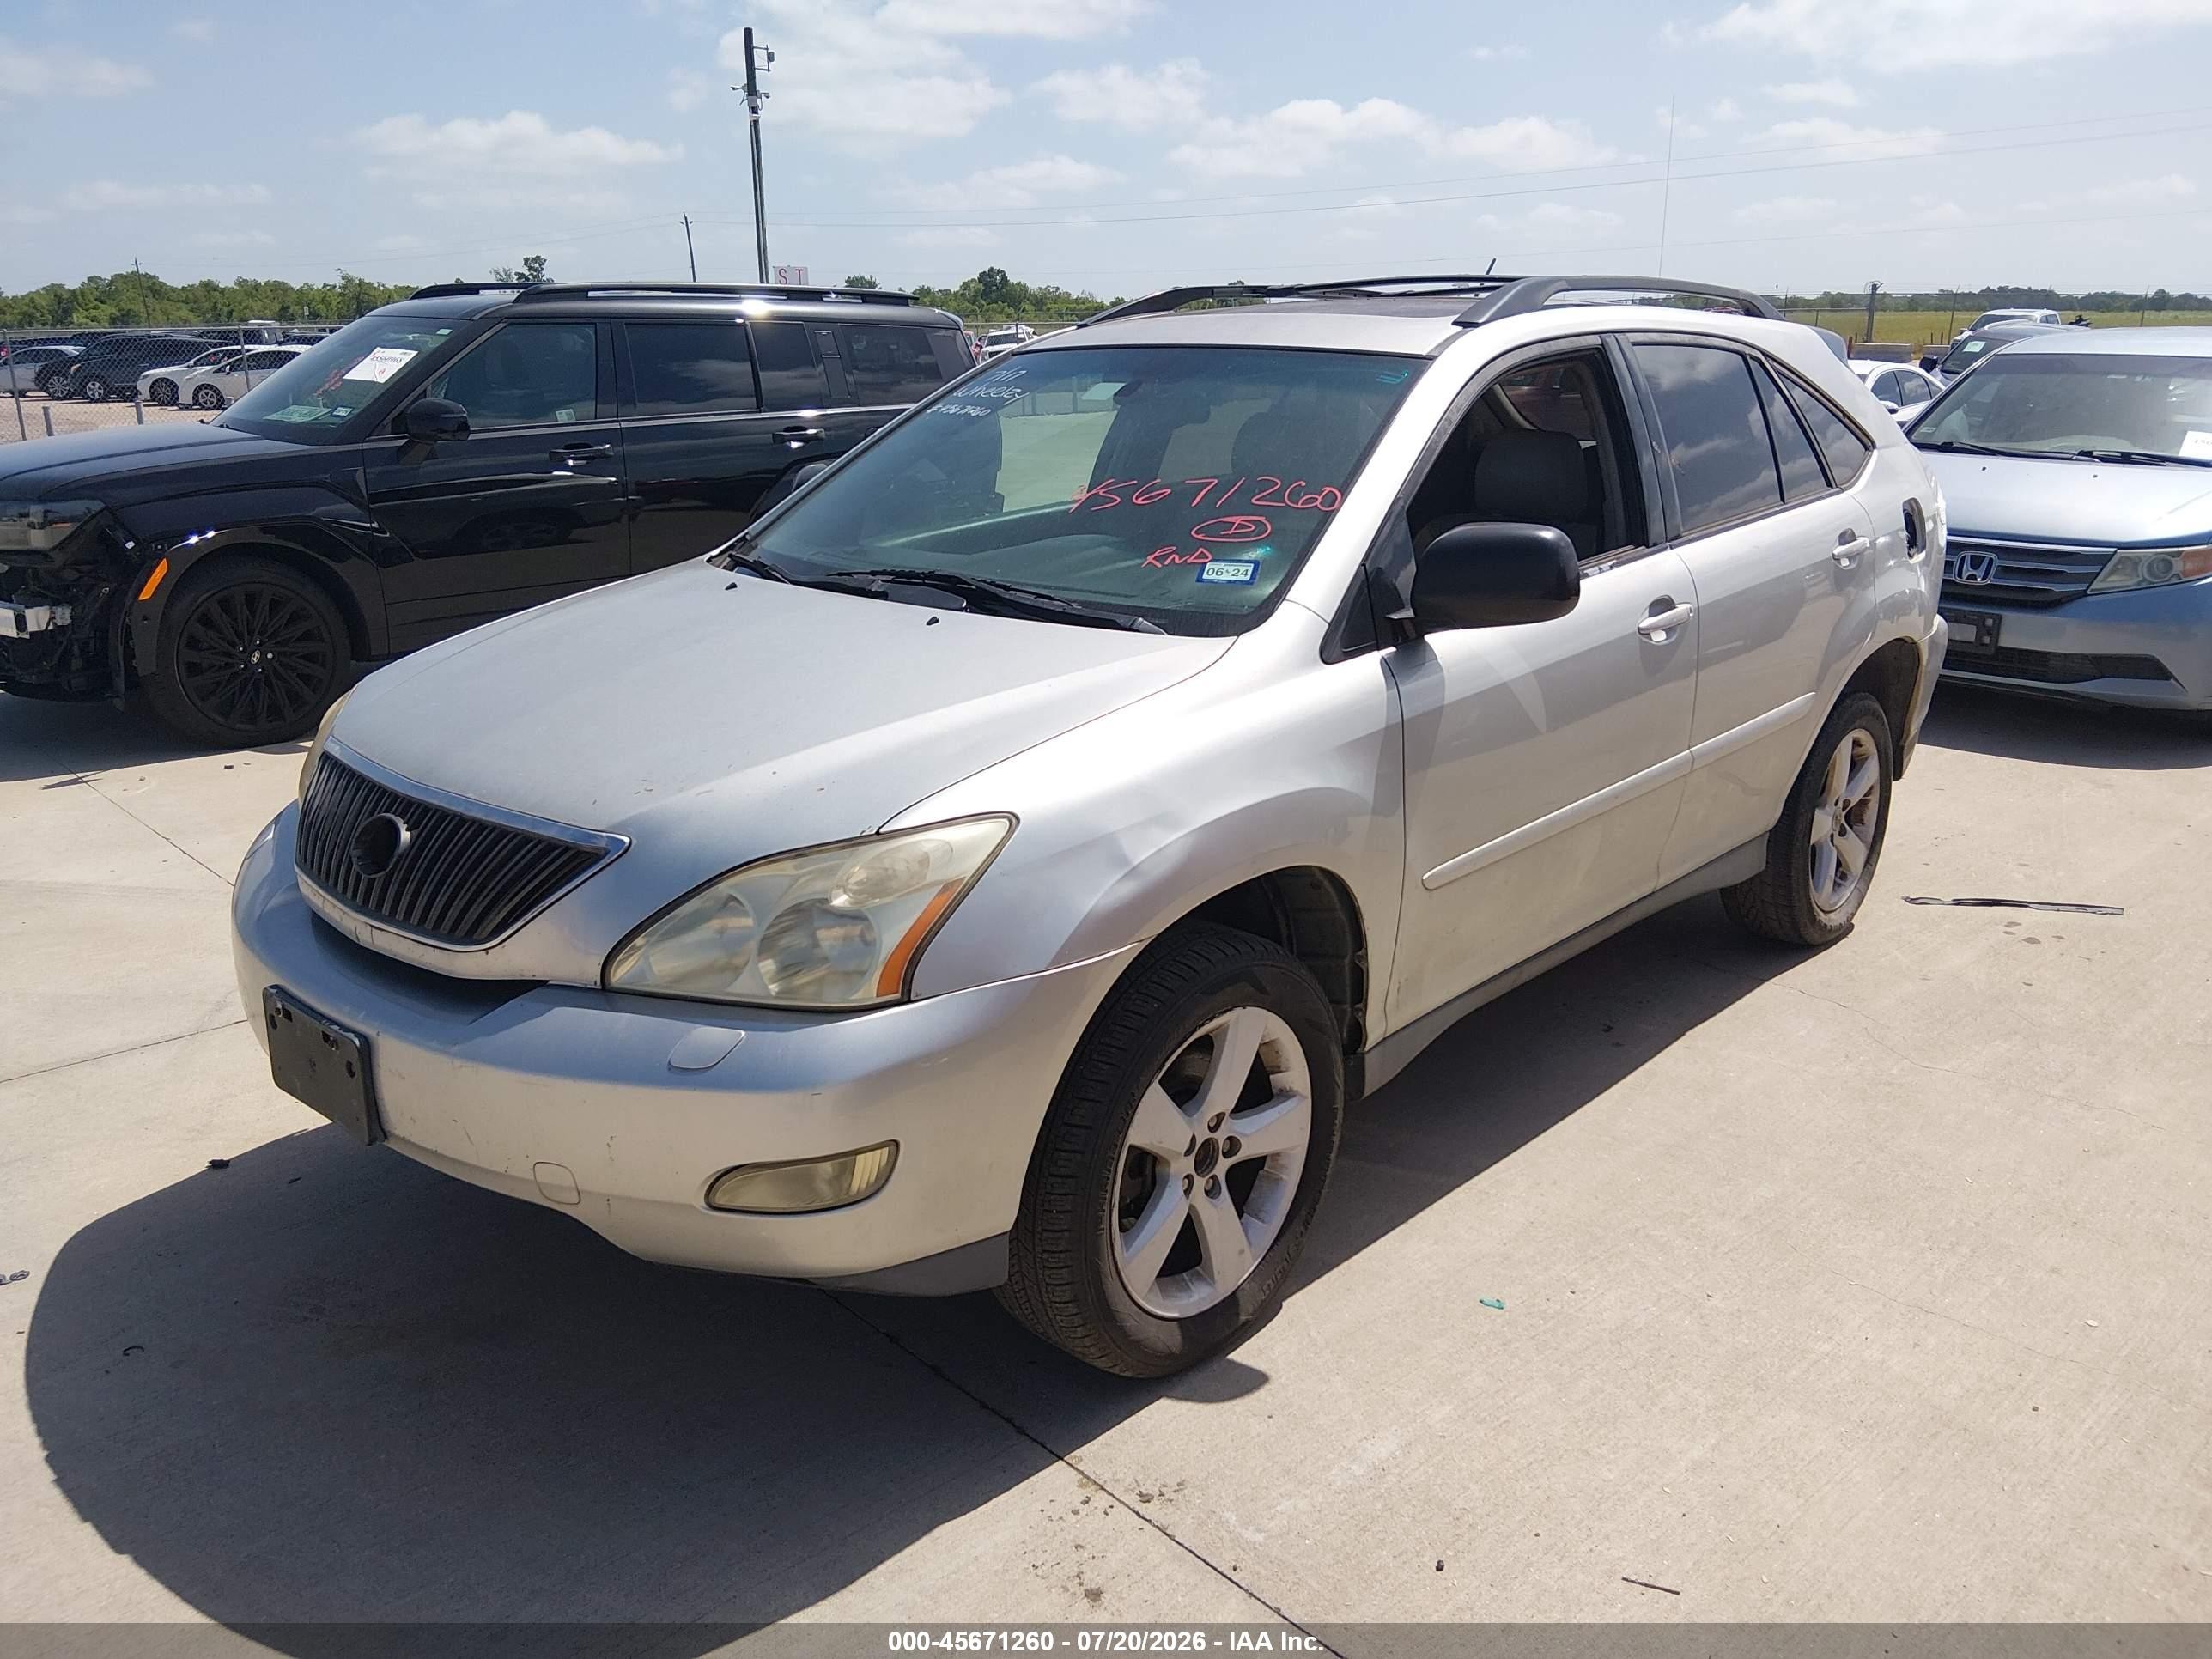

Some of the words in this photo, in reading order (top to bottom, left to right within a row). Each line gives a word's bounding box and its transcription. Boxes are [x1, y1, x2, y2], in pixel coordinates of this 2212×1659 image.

[1069, 476, 1342, 514] 45671260
[1140, 545, 1213, 568] RND
[1206, 568, 1224, 576] 06
[1231, 568, 1249, 577] 24
